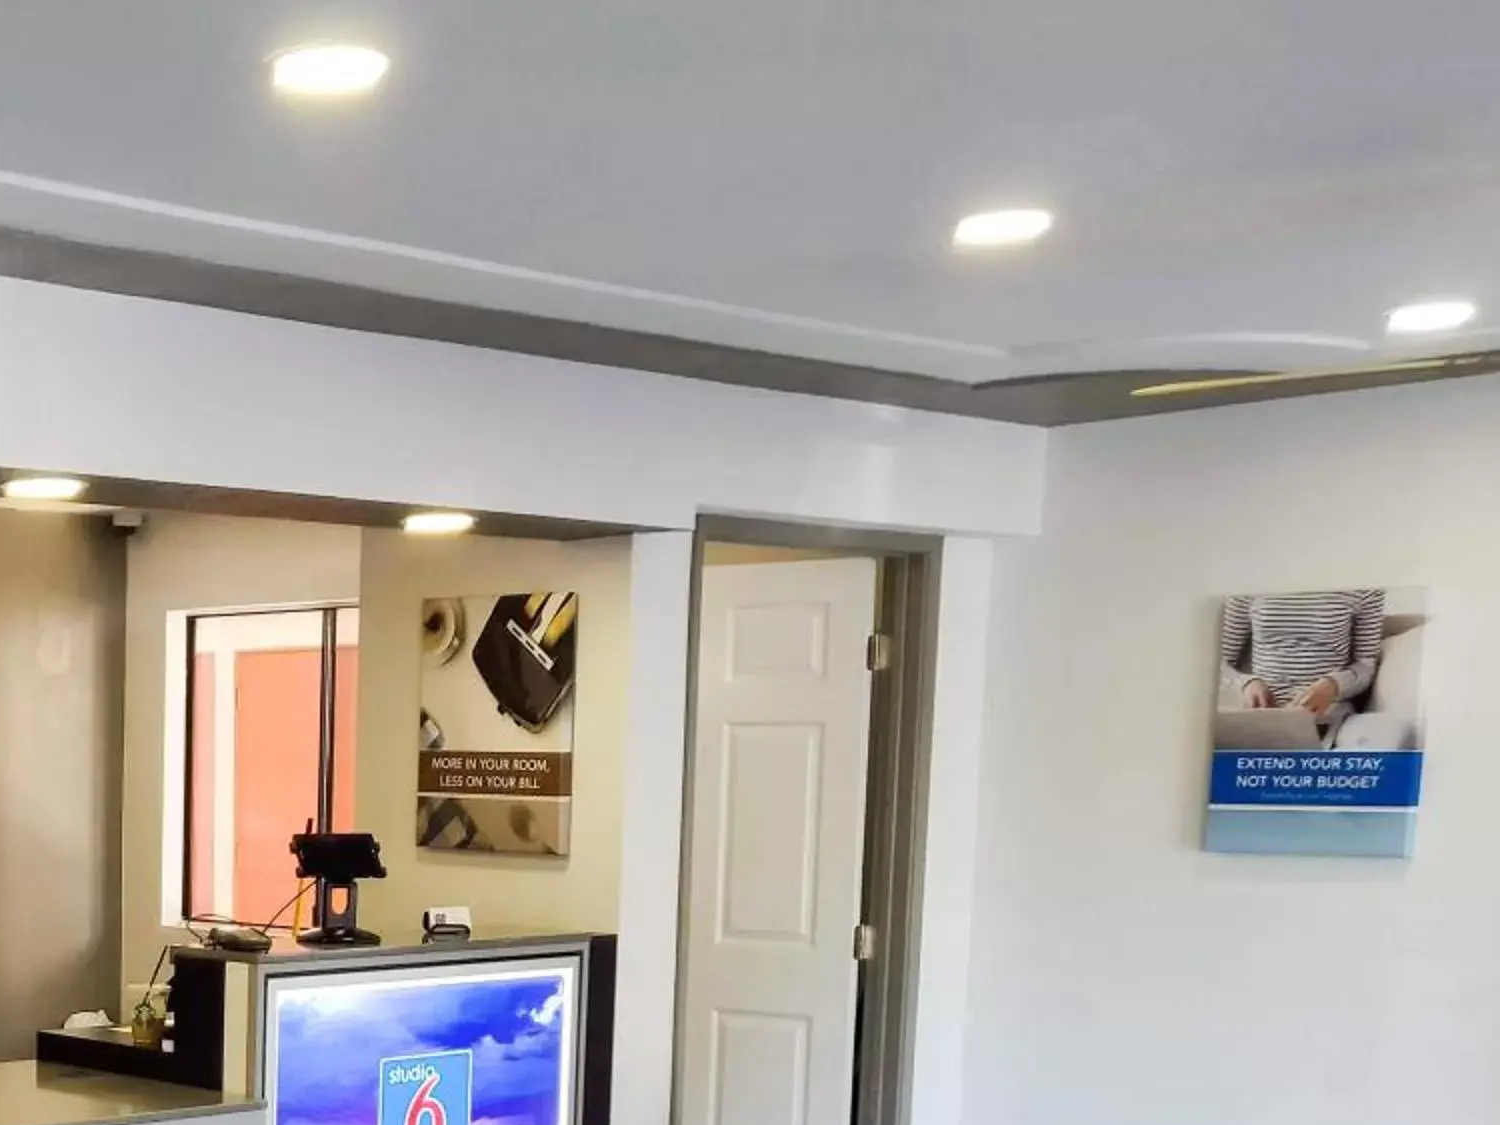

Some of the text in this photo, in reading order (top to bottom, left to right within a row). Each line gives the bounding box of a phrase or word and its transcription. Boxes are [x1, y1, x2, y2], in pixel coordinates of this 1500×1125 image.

[431, 756, 551, 773] MORE IN YOUR ROOM,
[1236, 756, 1296, 770] EXTEND
[1300, 757, 1342, 770] YOUR
[439, 774, 463, 788] LESS
[465, 775, 483, 788] ON
[485, 776, 517, 789] YOUR
[1235, 774, 1381, 790] NOT YOUR BUDGET
[388, 1063, 436, 1085] studio
